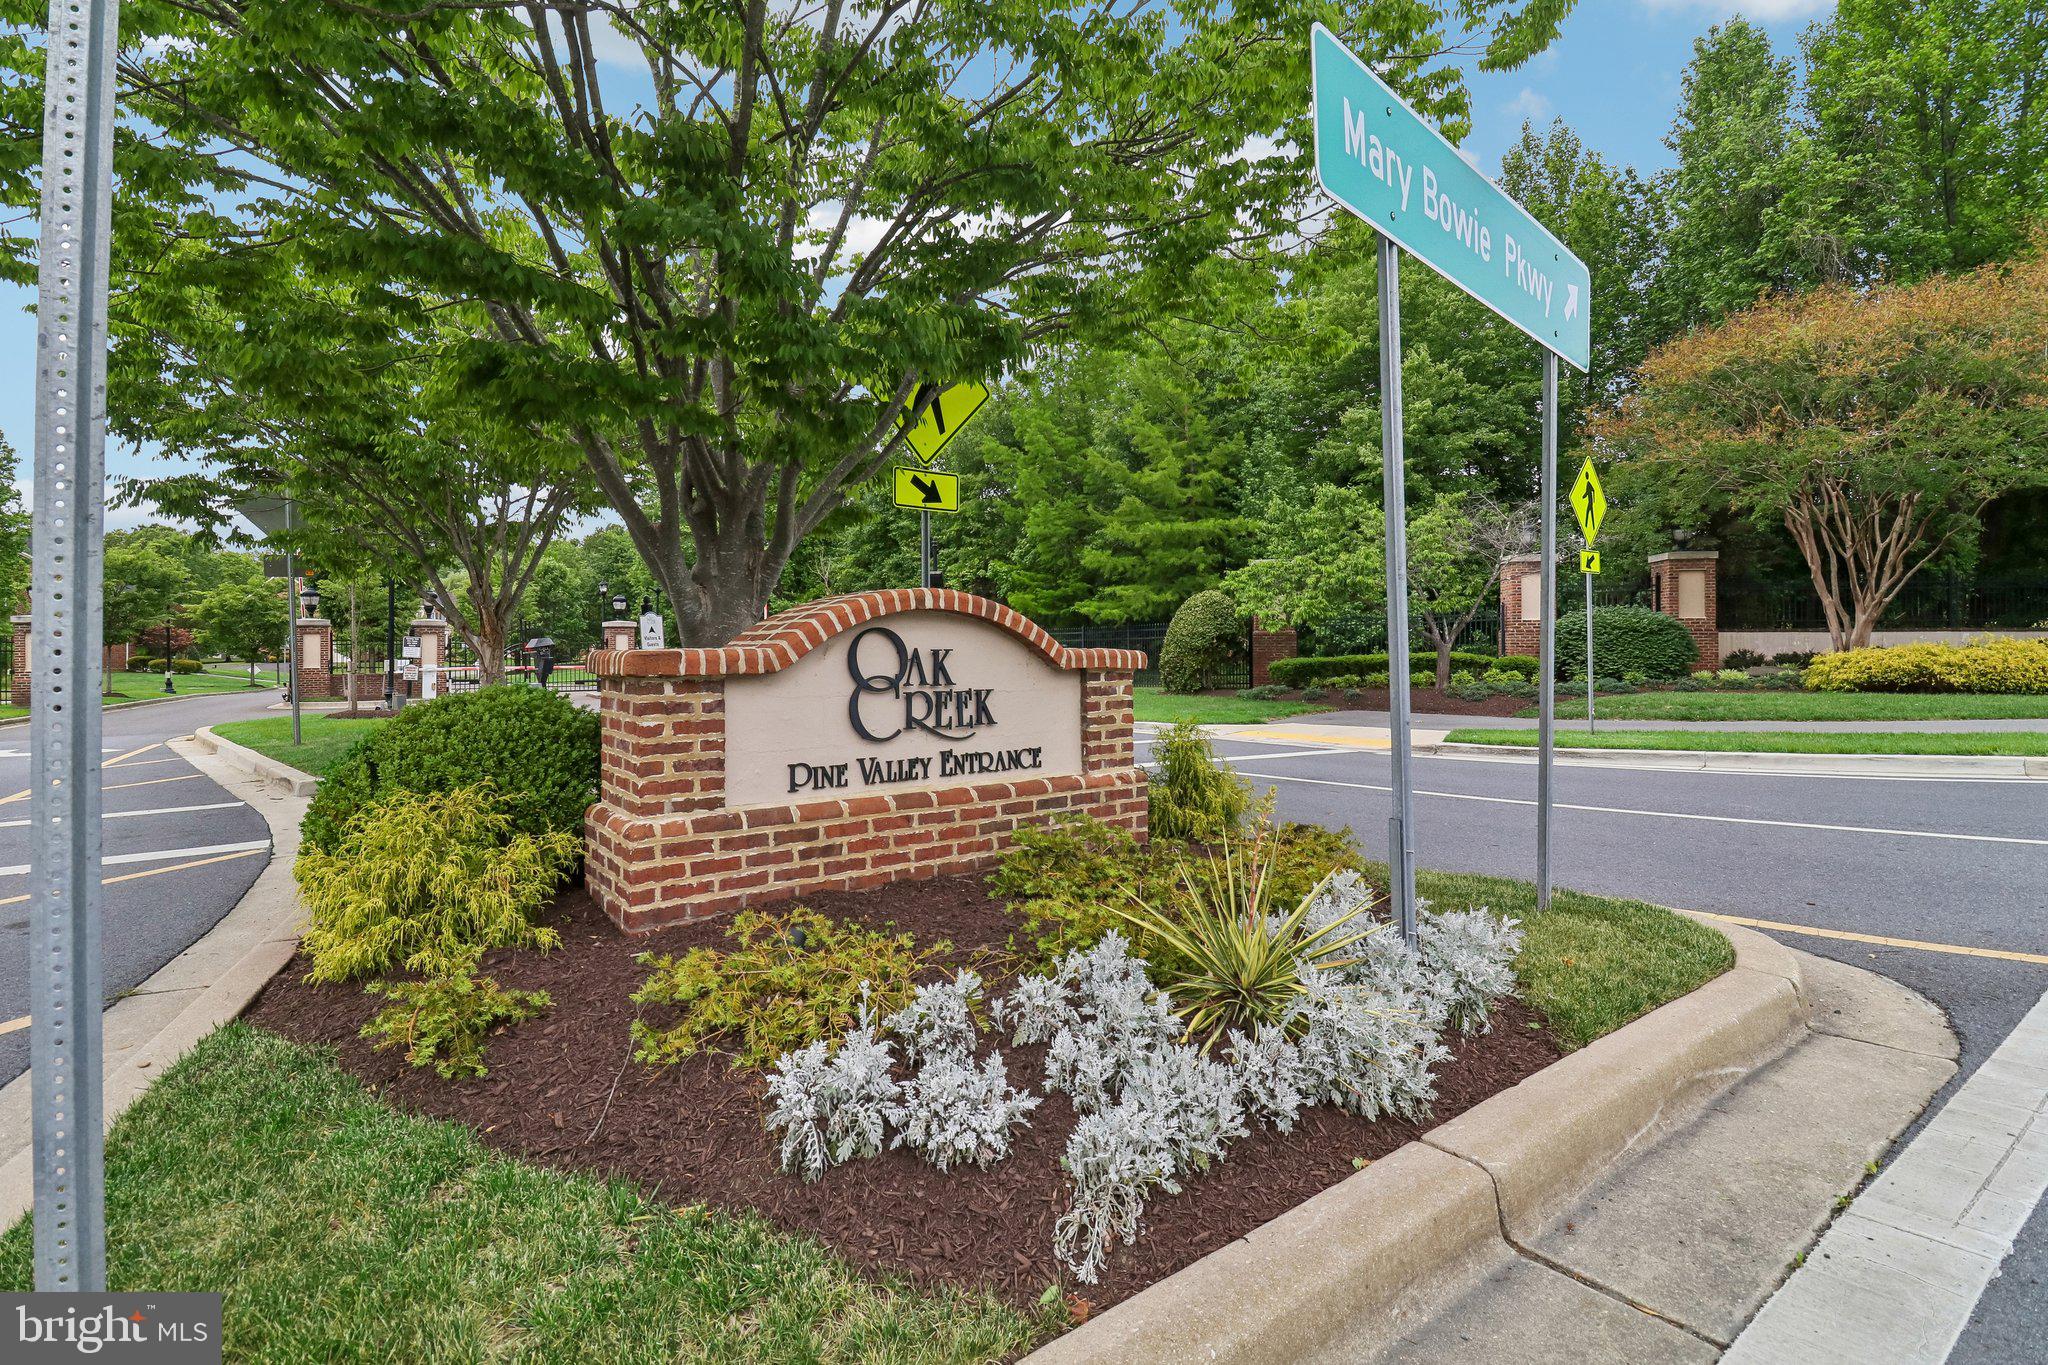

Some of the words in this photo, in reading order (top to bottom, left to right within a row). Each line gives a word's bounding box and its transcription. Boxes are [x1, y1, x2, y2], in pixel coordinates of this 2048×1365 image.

[1343, 96, 1412, 212] Mary
[1423, 164, 1491, 262] Bowie
[1505, 233, 1553, 318] Pkwy
[847, 627, 956, 694] OAK
[848, 675, 998, 743] CREEK
[787, 762, 848, 793] PINE
[856, 755, 932, 786] VALLEY
[939, 746, 1042, 777] ENTRANCE
